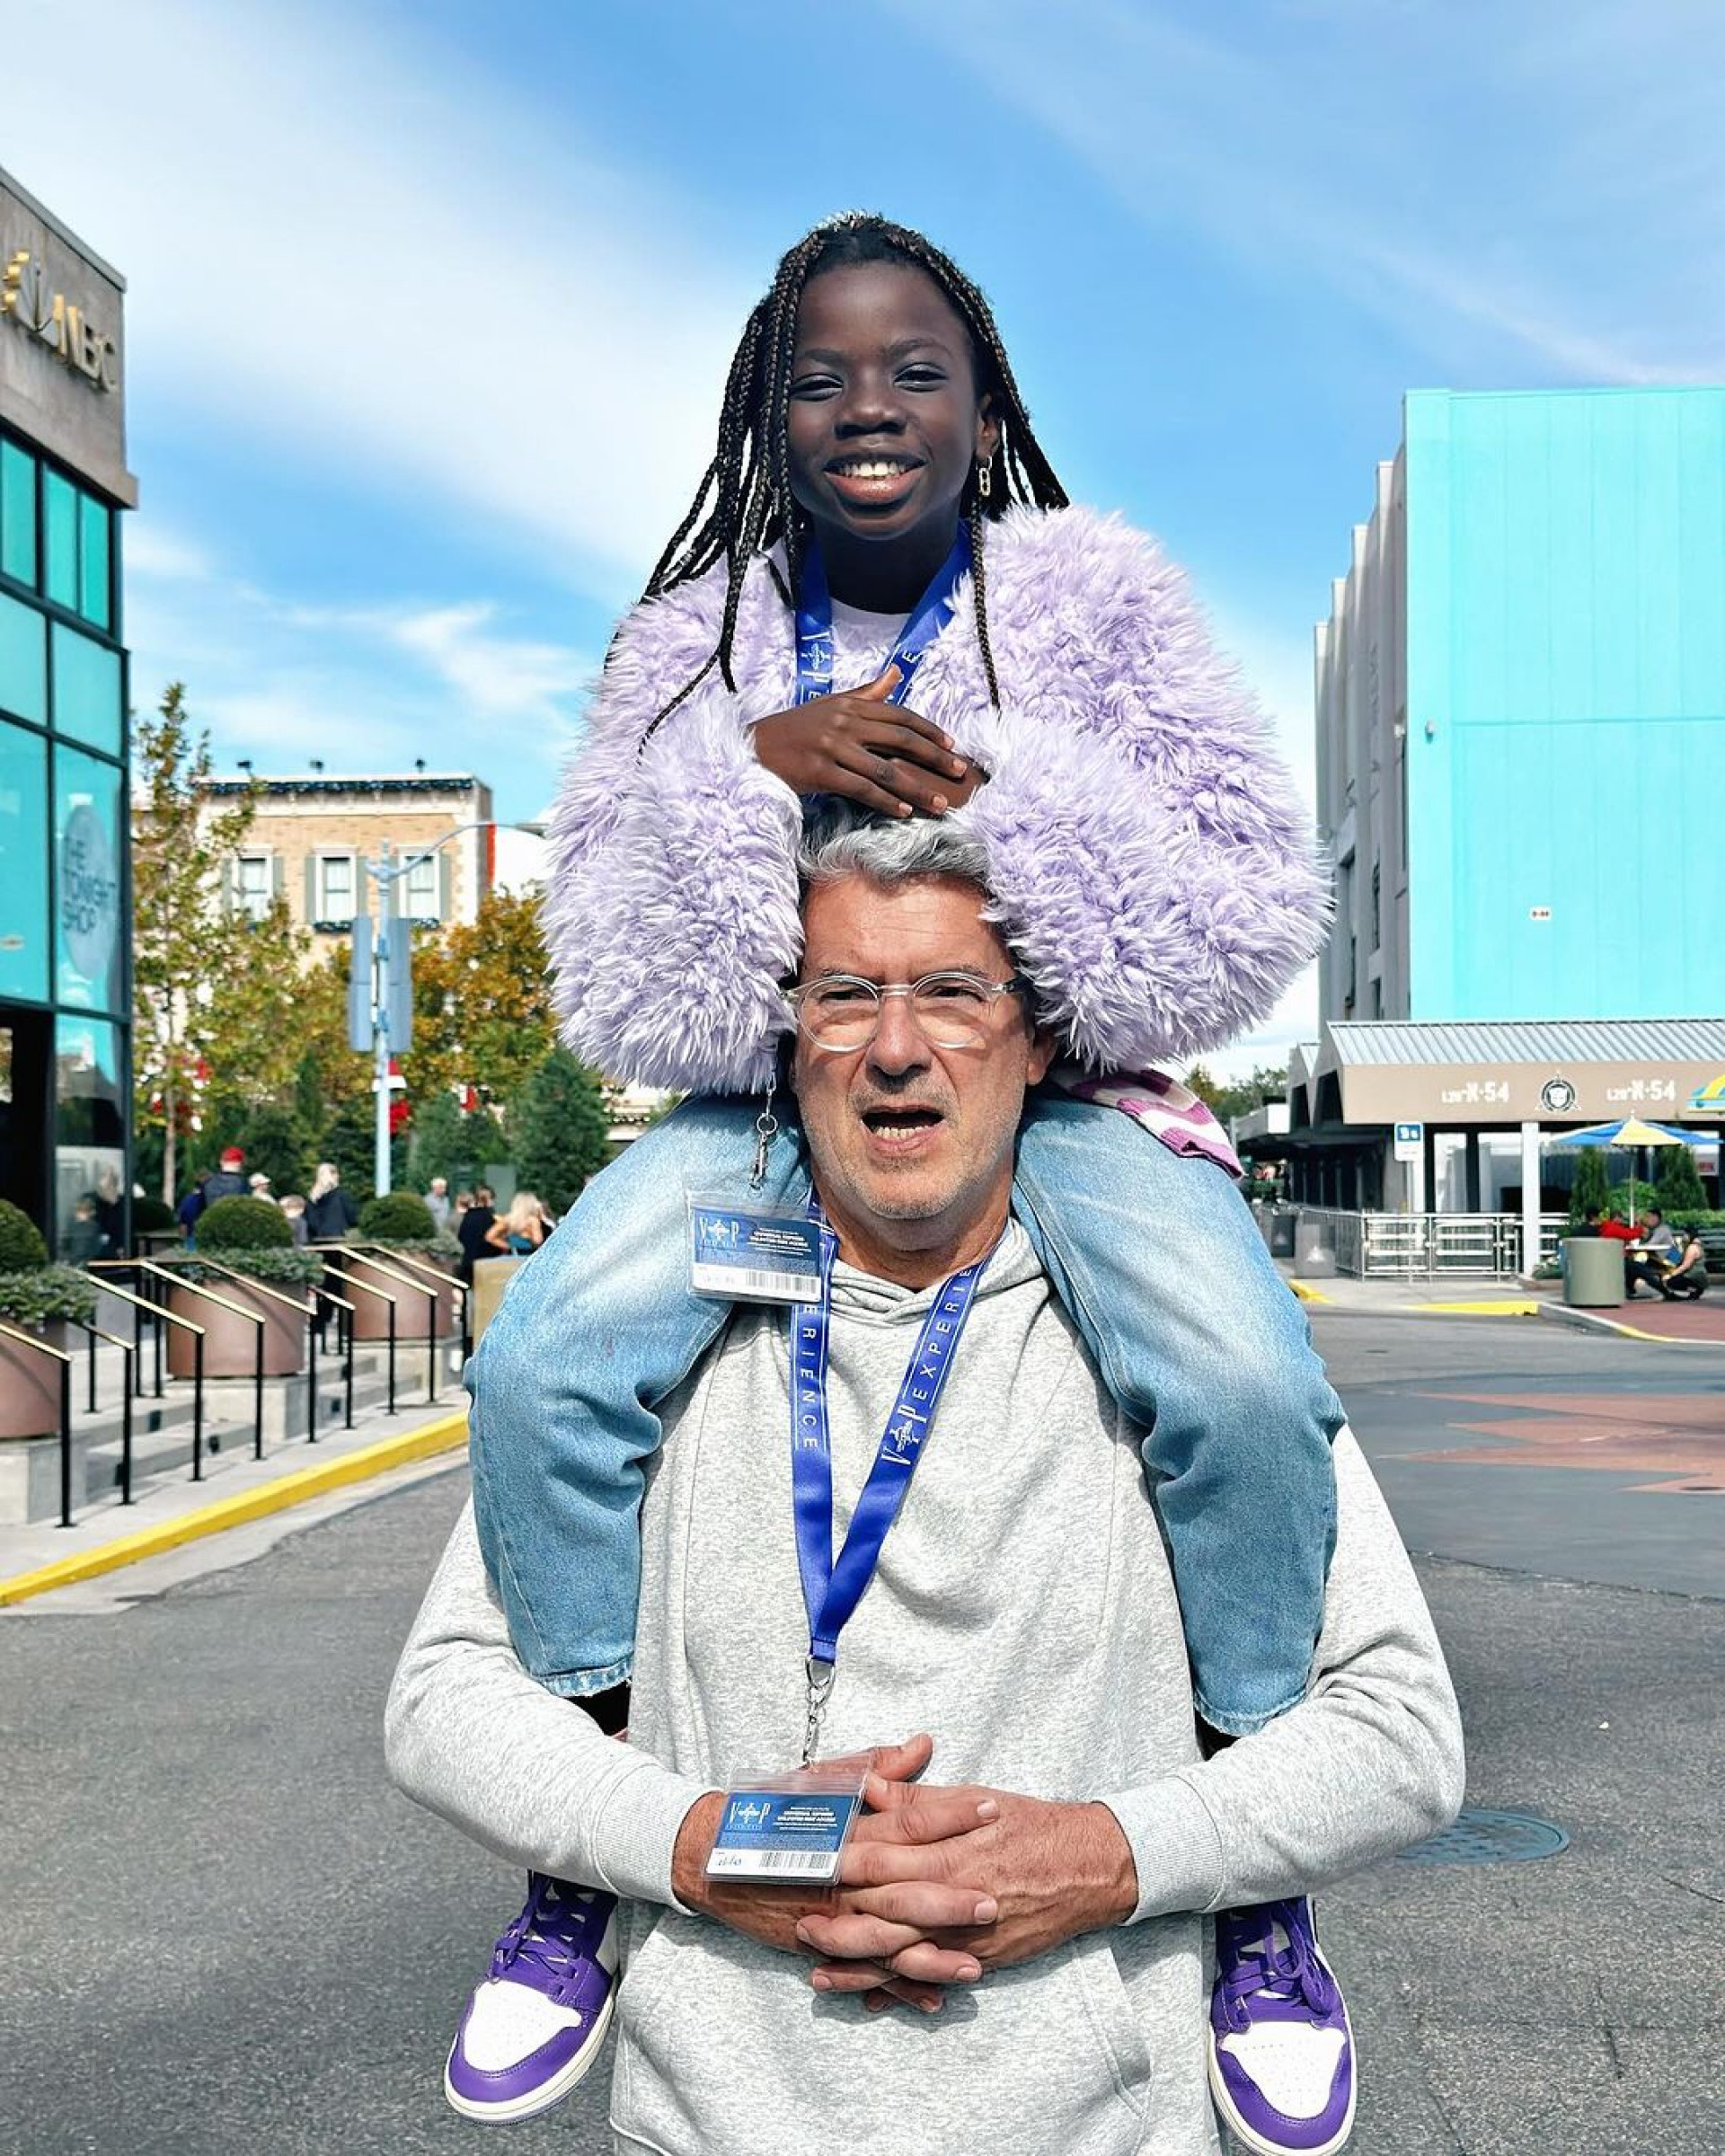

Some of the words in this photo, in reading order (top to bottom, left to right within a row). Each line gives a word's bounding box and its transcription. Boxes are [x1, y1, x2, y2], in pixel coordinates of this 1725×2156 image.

[53, 293, 118, 390] NBC
[800, 1303, 818, 1449] ERIENCE
[913, 1267, 972, 1401] EXPERIE
